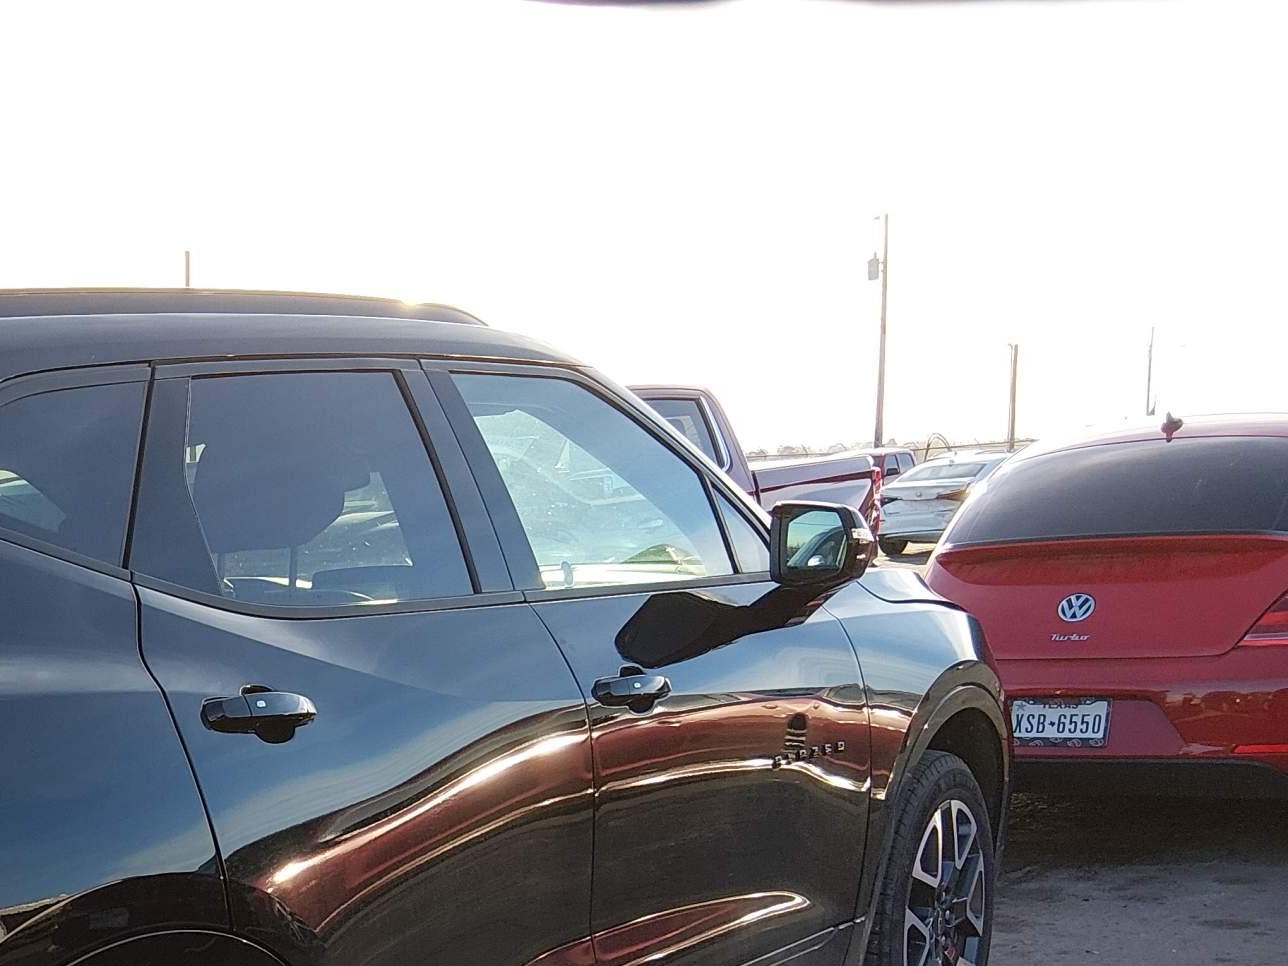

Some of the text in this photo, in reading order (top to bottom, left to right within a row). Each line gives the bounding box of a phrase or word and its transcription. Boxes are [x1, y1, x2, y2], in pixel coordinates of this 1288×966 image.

[1050, 633, 1091, 641] Turbo
[1014, 713, 1102, 734] XSB 6550
